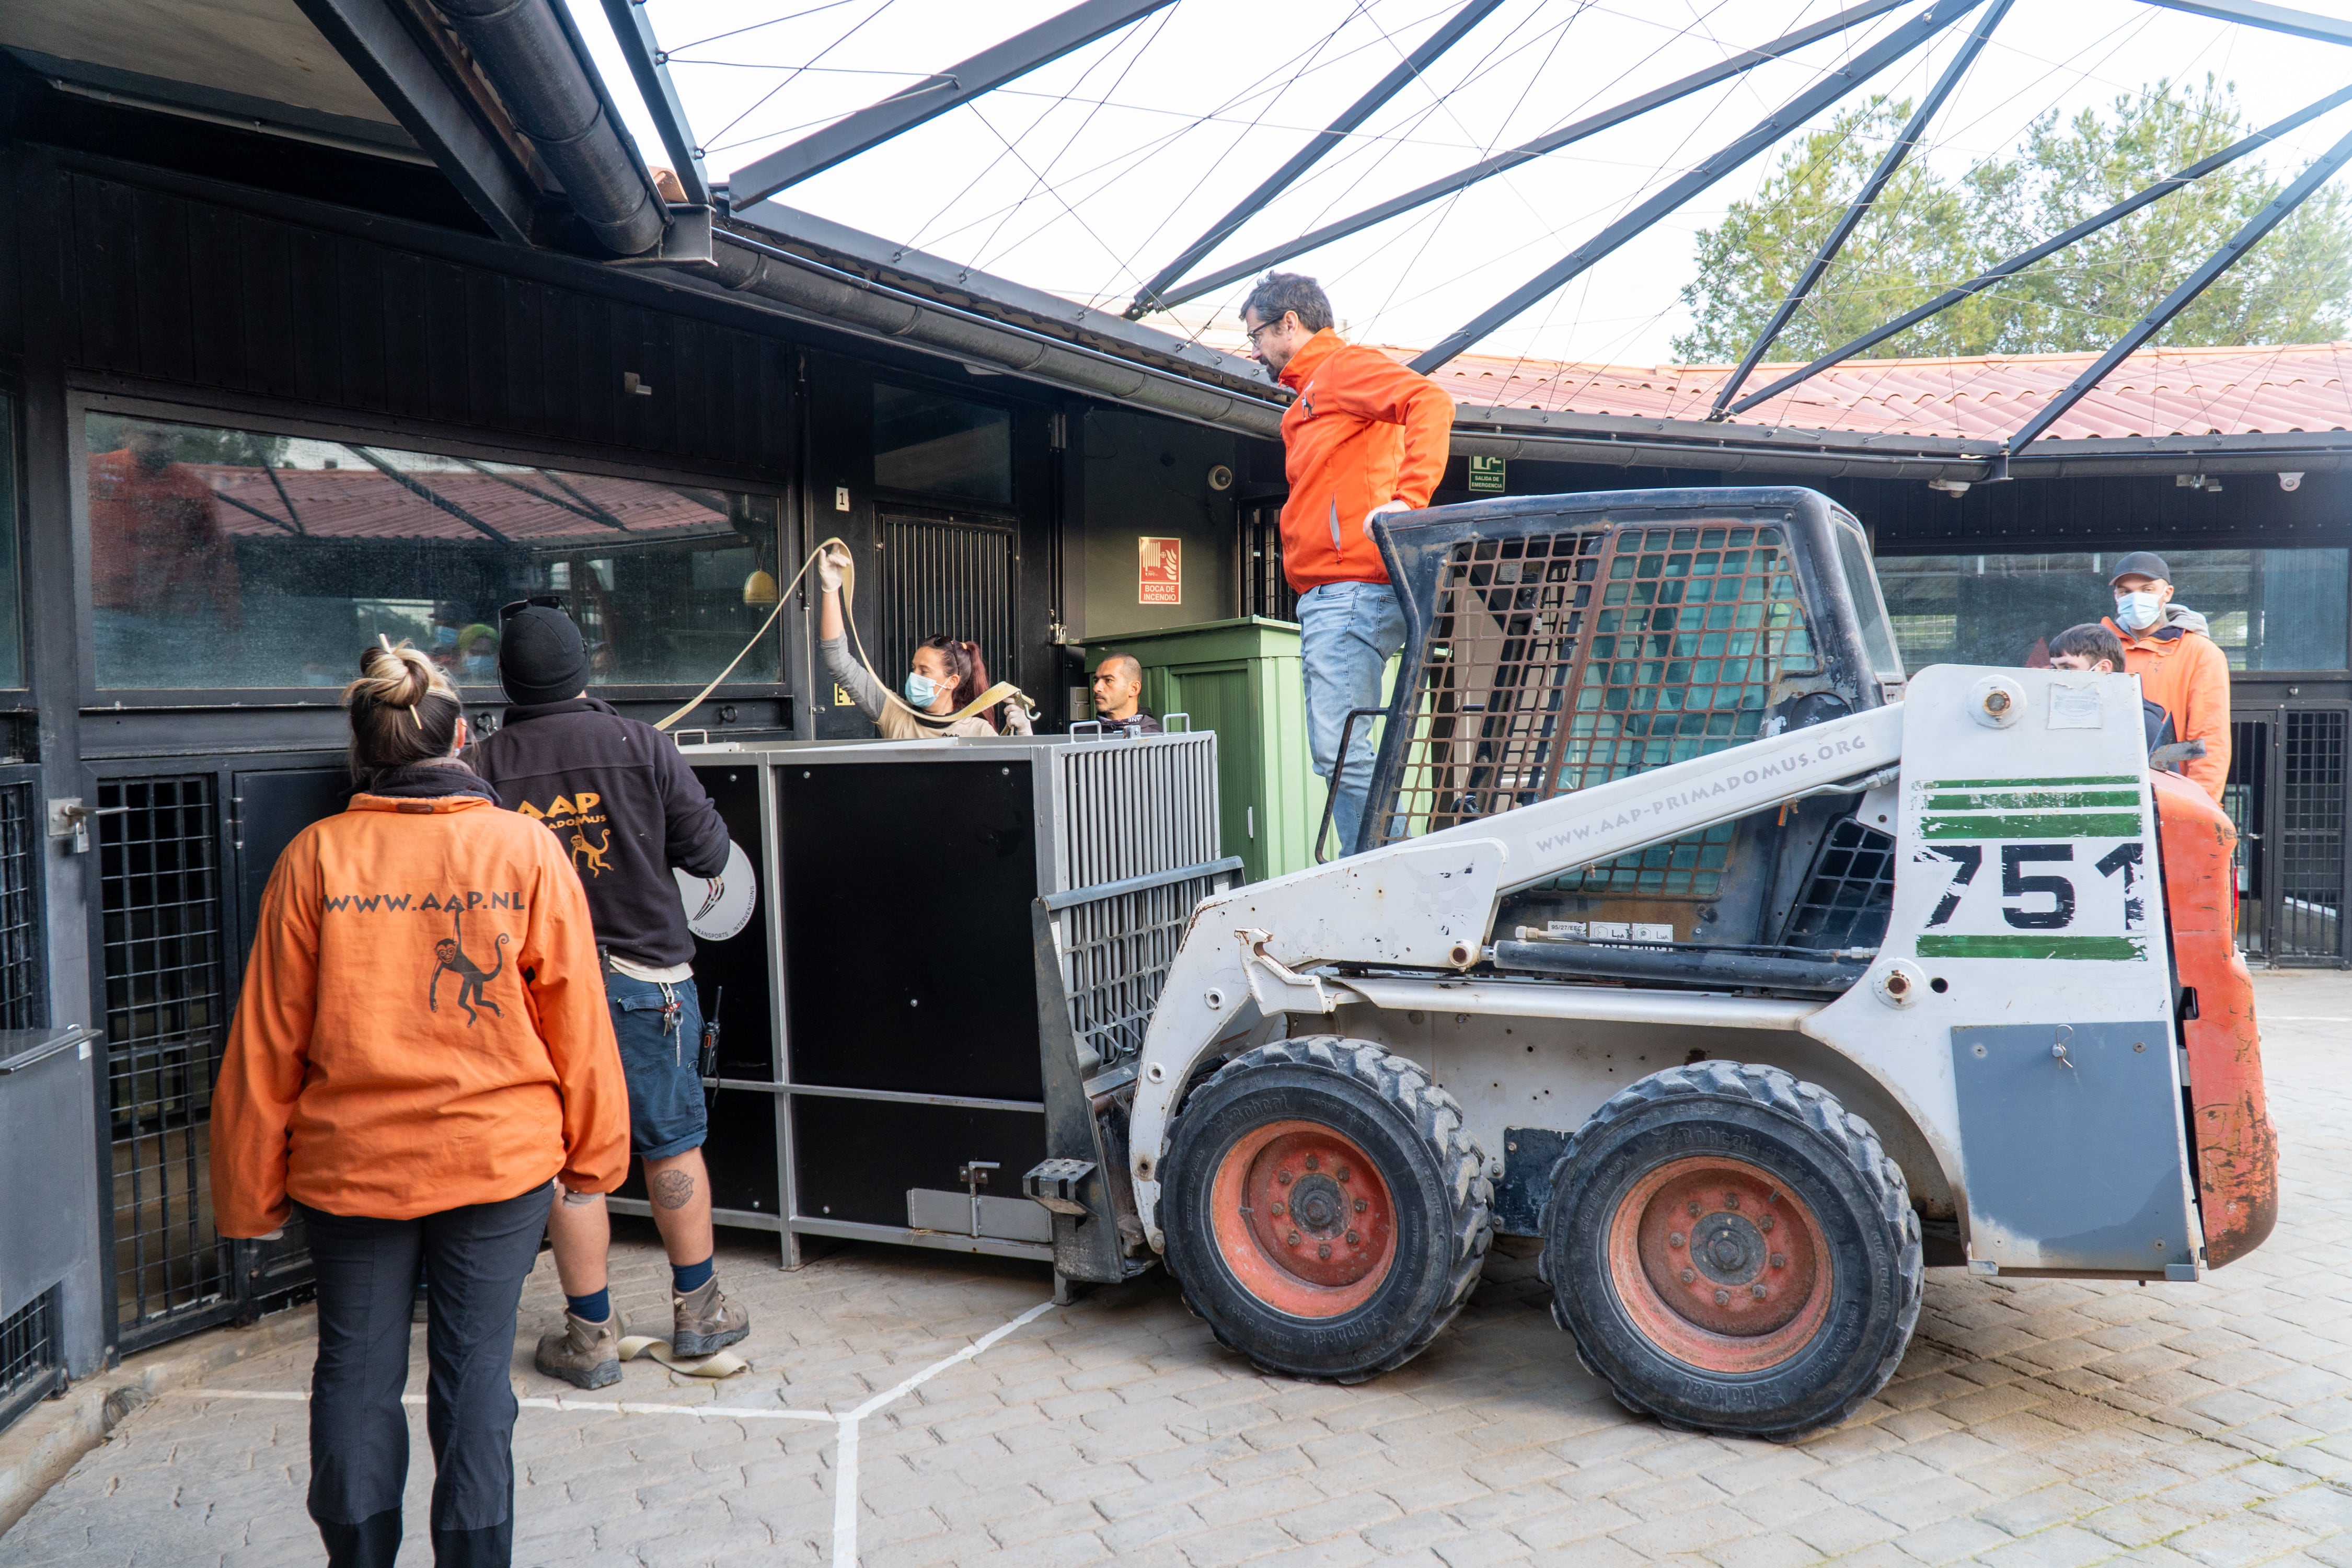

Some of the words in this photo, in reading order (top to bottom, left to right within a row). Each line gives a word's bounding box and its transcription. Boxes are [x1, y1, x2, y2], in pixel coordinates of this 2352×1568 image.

[839, 492, 845, 505] 1
[516, 792, 600, 820] AAP
[1536, 735, 1866, 853] WWW.AAP-PRIMADOMUS.ORG
[548, 814, 607, 829] ADOMUS
[1913, 843, 2145, 930] 751
[323, 891, 525, 914] WWW.AAP.NL
[694, 927, 729, 939] TRANSPORTS
[733, 885, 755, 932] INTERVENTIONS
